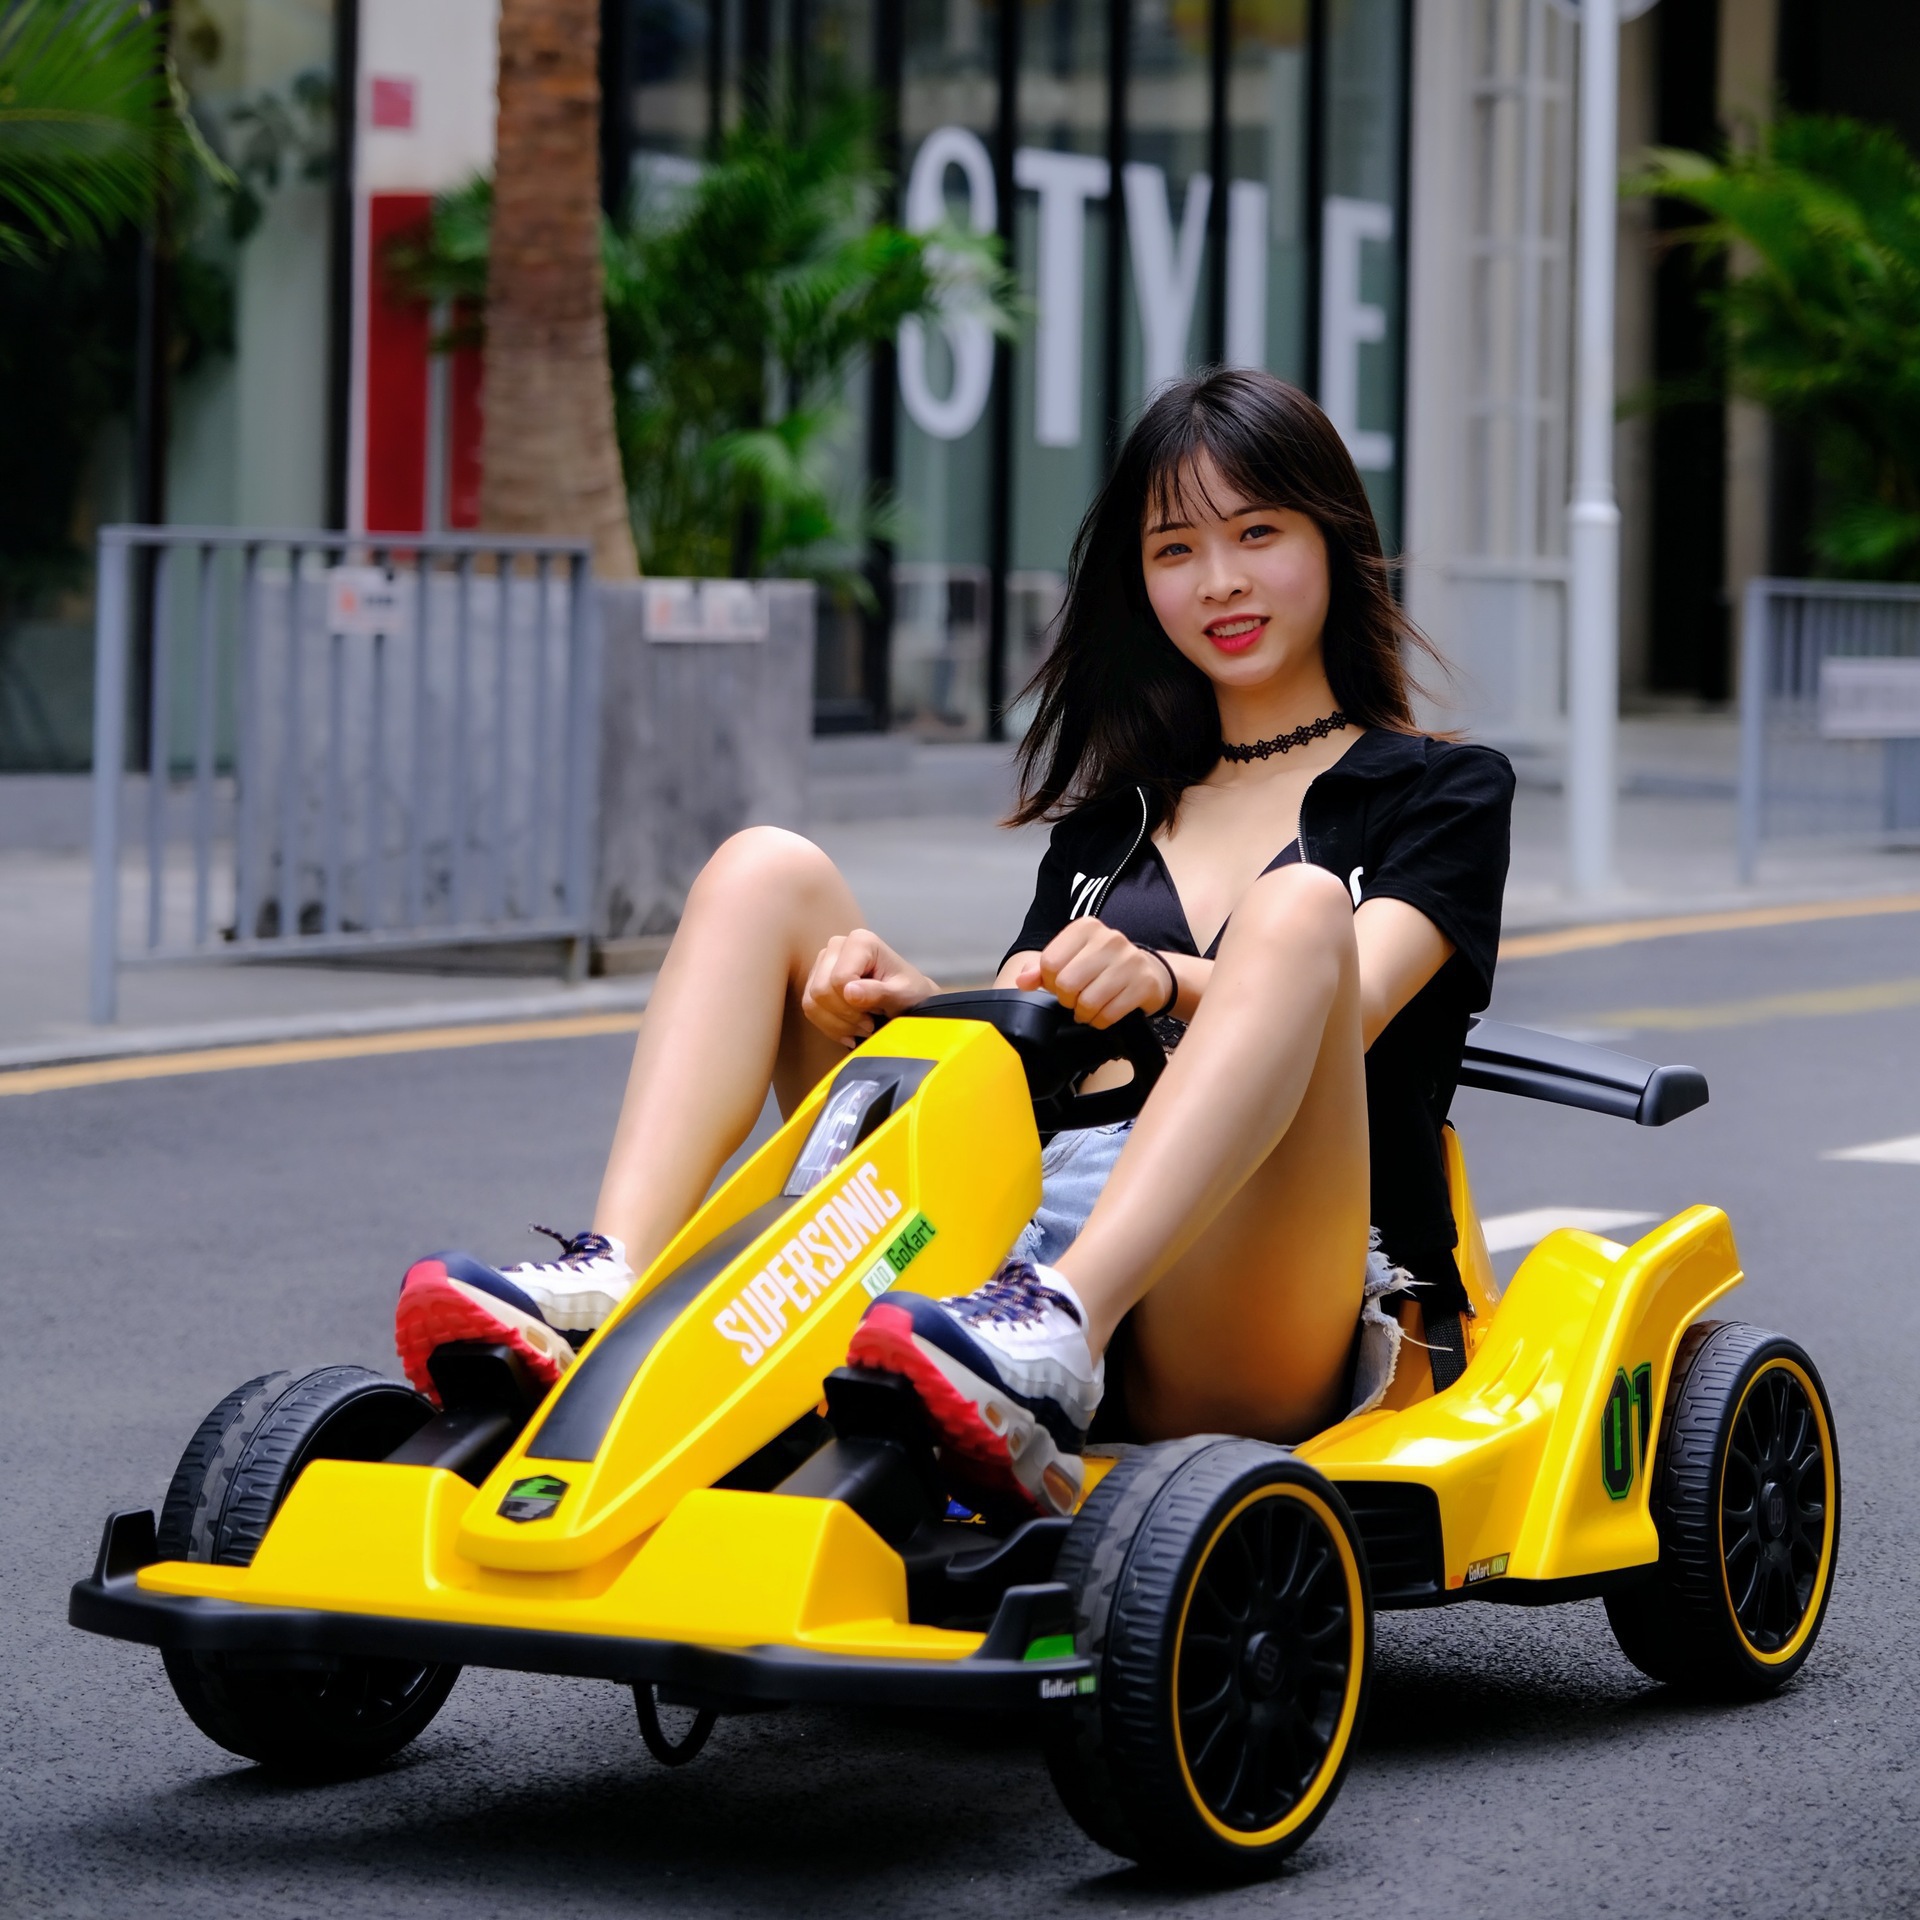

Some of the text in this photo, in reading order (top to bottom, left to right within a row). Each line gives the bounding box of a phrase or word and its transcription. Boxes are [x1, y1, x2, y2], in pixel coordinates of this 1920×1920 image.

[713, 1161, 902, 1367] SUPERSONIC
[885, 1219, 936, 1273] GoKart
[1601, 1361, 1653, 1501] 01
[1468, 1562, 1490, 1582] GoKart
[1041, 1678, 1077, 1698] GoKart
